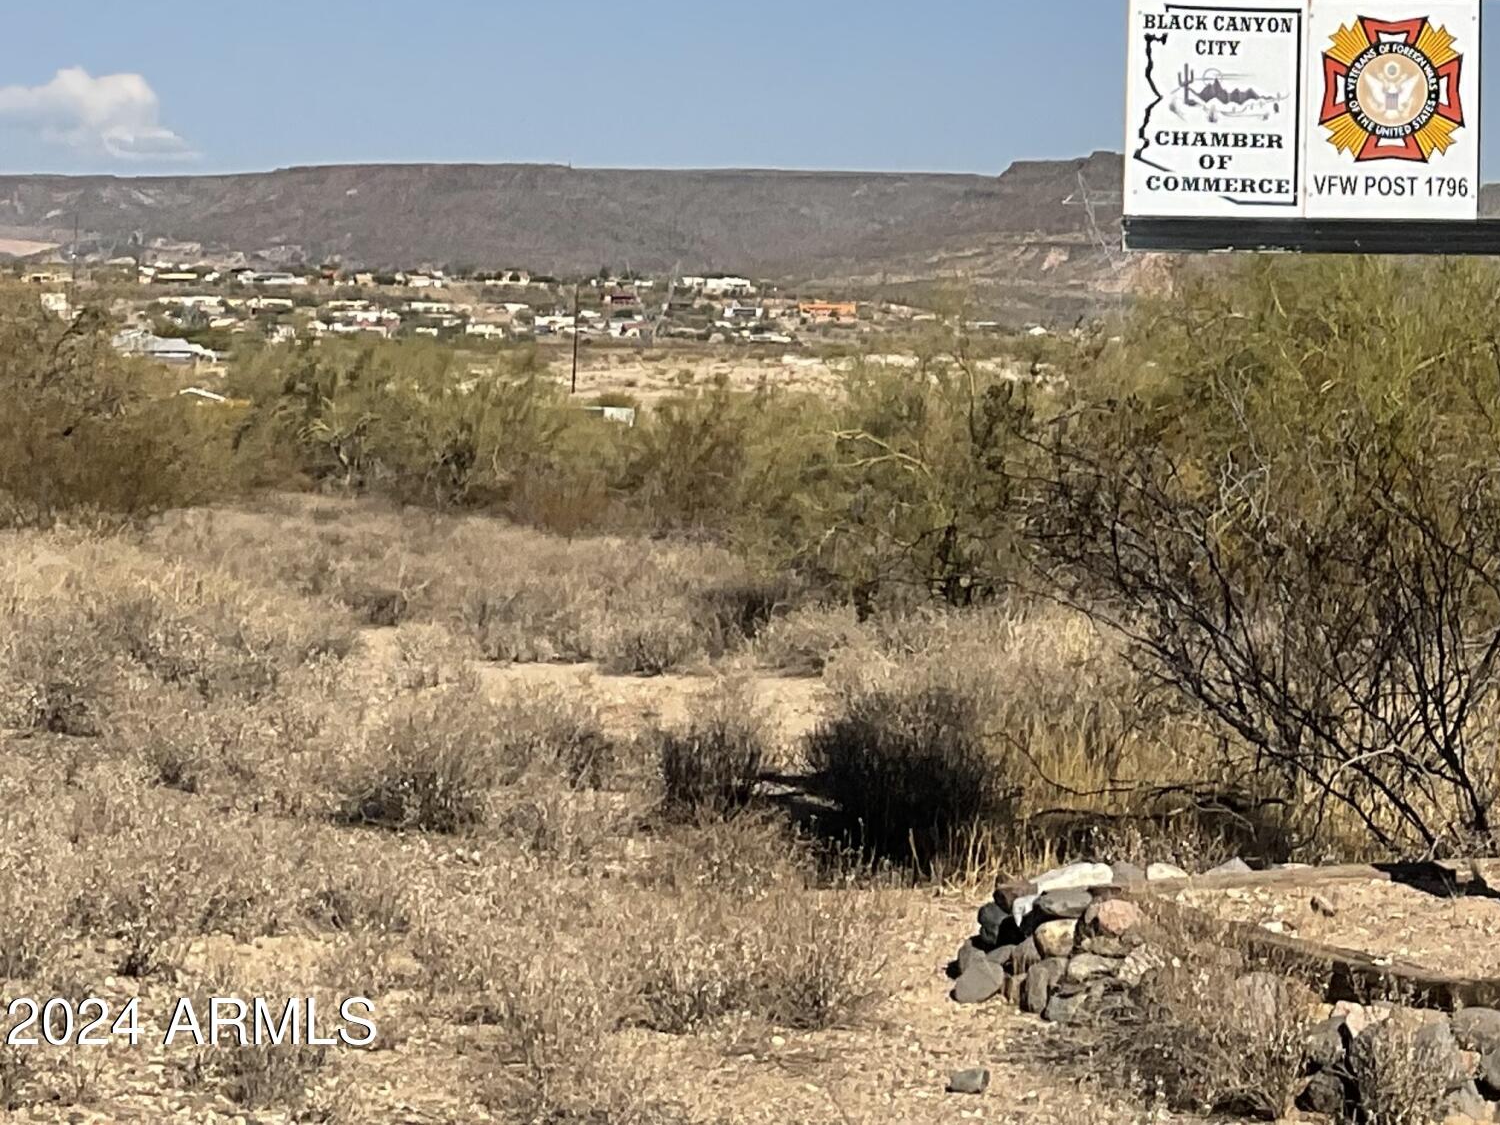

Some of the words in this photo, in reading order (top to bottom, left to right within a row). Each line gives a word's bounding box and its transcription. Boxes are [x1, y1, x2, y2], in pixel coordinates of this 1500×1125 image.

[1143, 13, 1208, 31] BLACK
[1213, 15, 1293, 33] CANYON
[1195, 40, 1240, 56] CITY
[1347, 48, 1377, 91] VETERANS
[1379, 43, 1390, 53] OF
[1392, 44, 1426, 66] FOREIGN
[1424, 63, 1438, 91] WARS
[1349, 100, 1360, 112] OF
[1357, 113, 1375, 131] THE
[1376, 125, 1411, 136] UNITED
[1412, 99, 1436, 129] STATES
[1154, 131, 1283, 149] CHAMBER
[1199, 155, 1232, 169] OF
[1146, 176, 1290, 194] COMMERCE
[1314, 175, 1358, 195] VFW
[1365, 176, 1418, 196] POST
[1425, 177, 1468, 197] 1796
